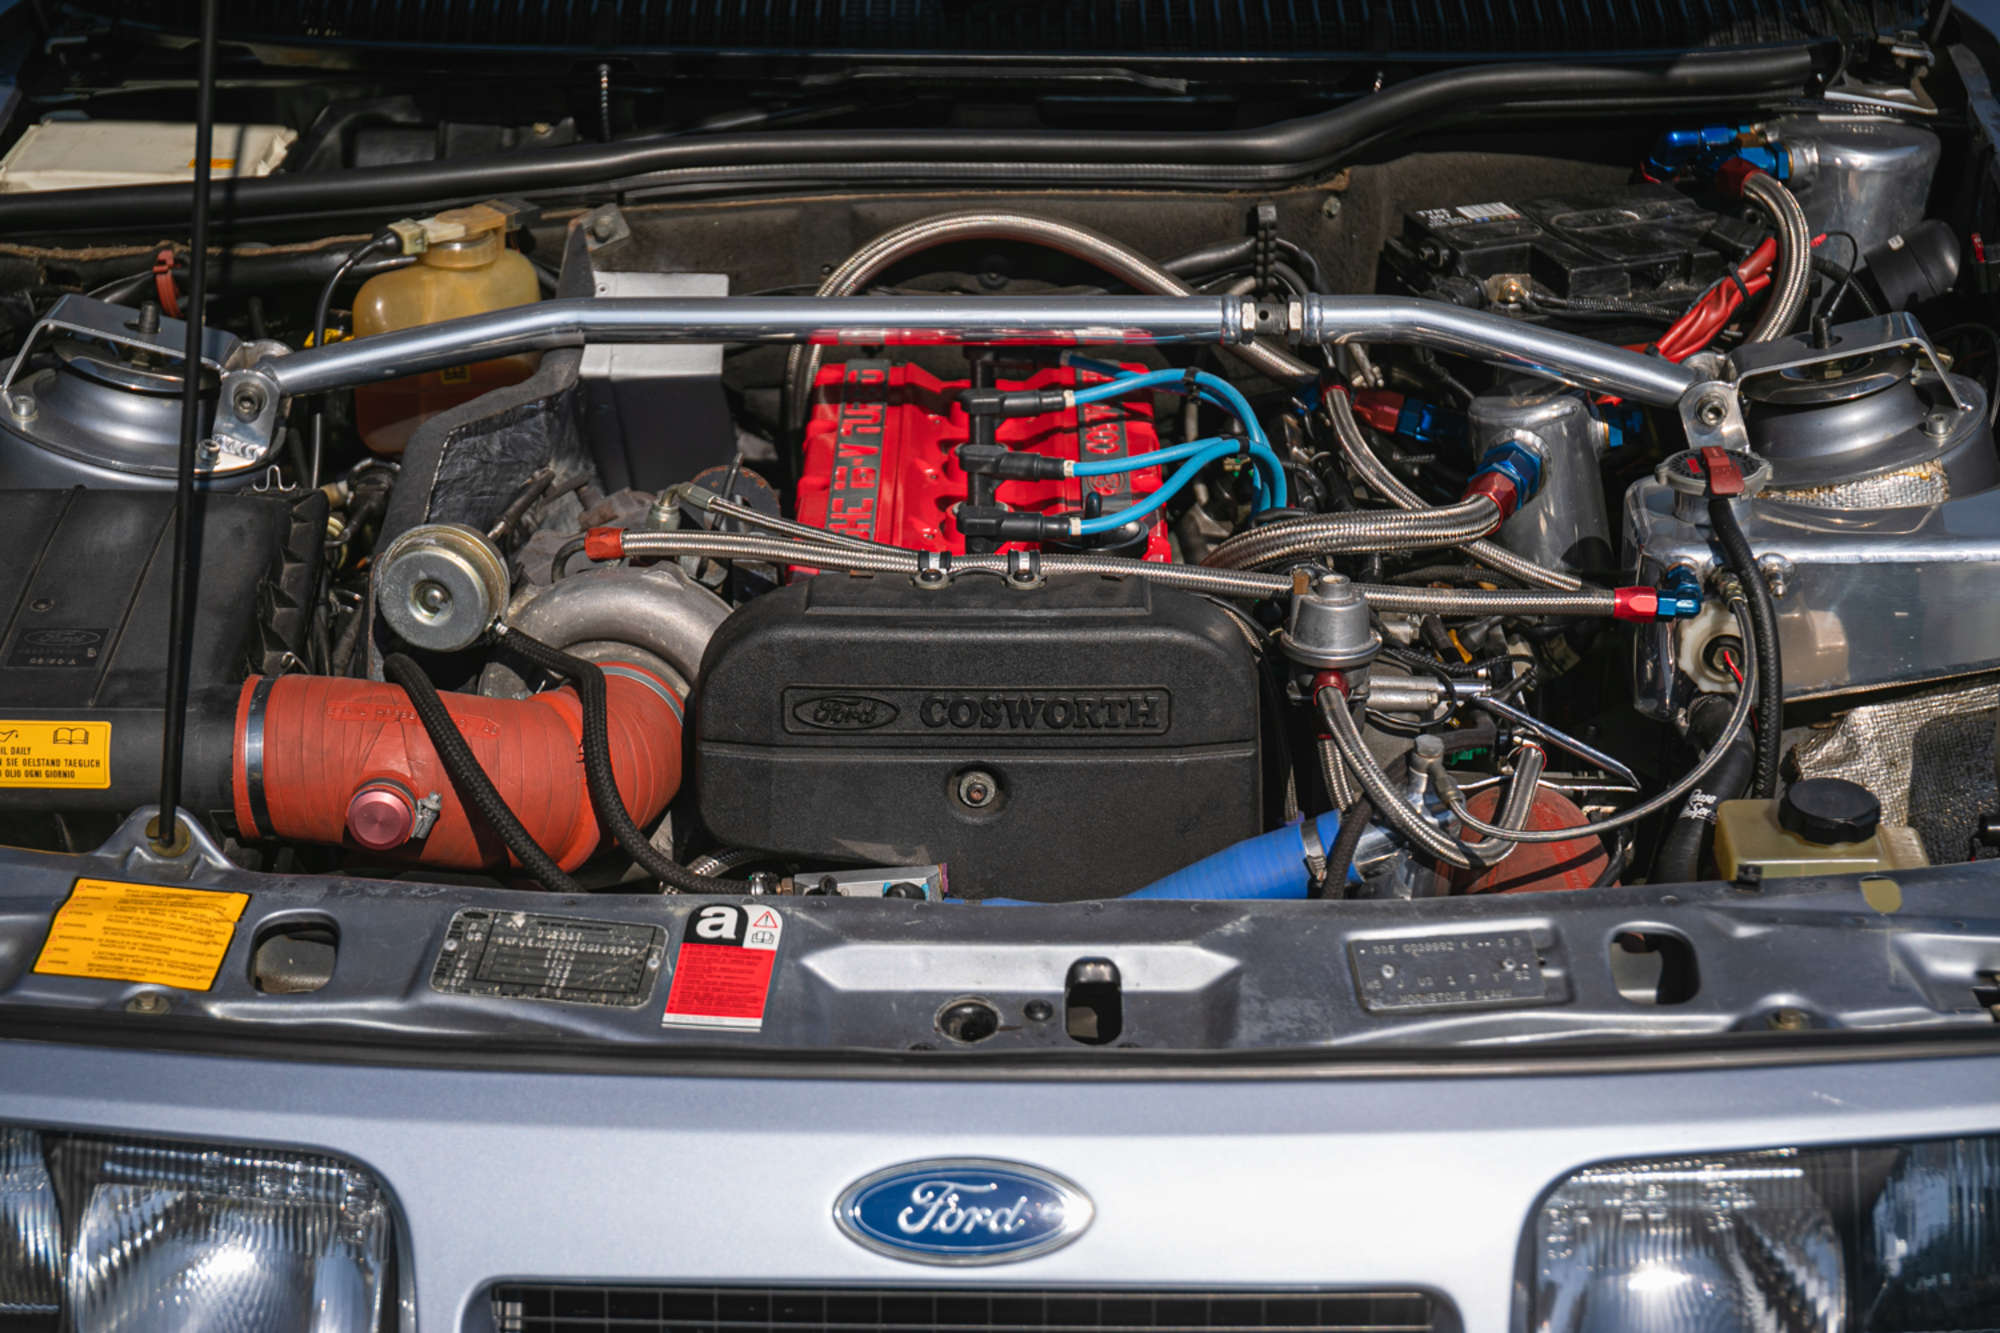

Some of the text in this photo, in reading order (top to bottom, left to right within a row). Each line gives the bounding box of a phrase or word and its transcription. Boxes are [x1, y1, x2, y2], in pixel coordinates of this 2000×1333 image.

[813, 696, 1159, 729] Ford COSWORTH
[6, 758, 18, 767] SIE
[22, 758, 61, 768] OELSTAND
[64, 759, 100, 768] TAEGLICH
[10, 747, 31, 755] DAILY
[696, 906, 738, 939] a
[898, 1181, 1028, 1234] Ford
